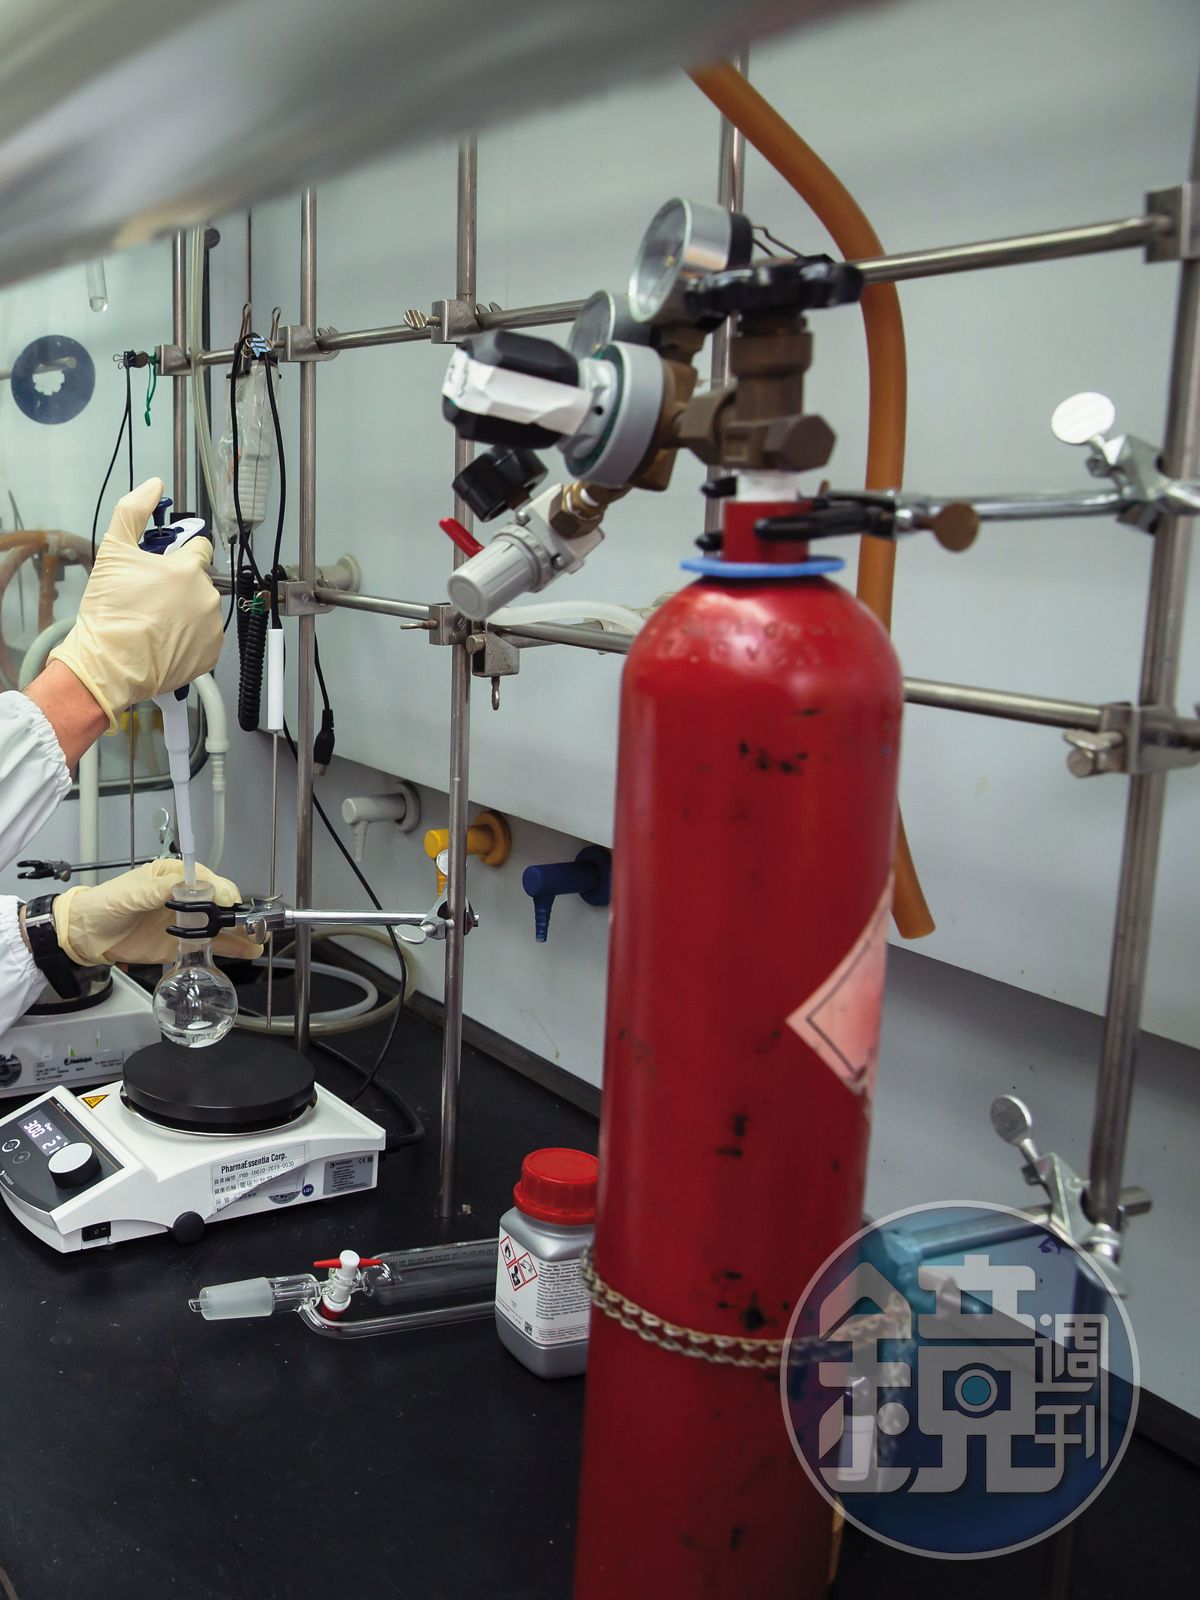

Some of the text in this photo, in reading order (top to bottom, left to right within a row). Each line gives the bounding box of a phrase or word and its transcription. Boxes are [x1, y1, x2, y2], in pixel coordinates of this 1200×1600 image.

[24, 1120, 46, 1138] 300
[221, 1152, 287, 1174] PharmaEssentia Corp.
